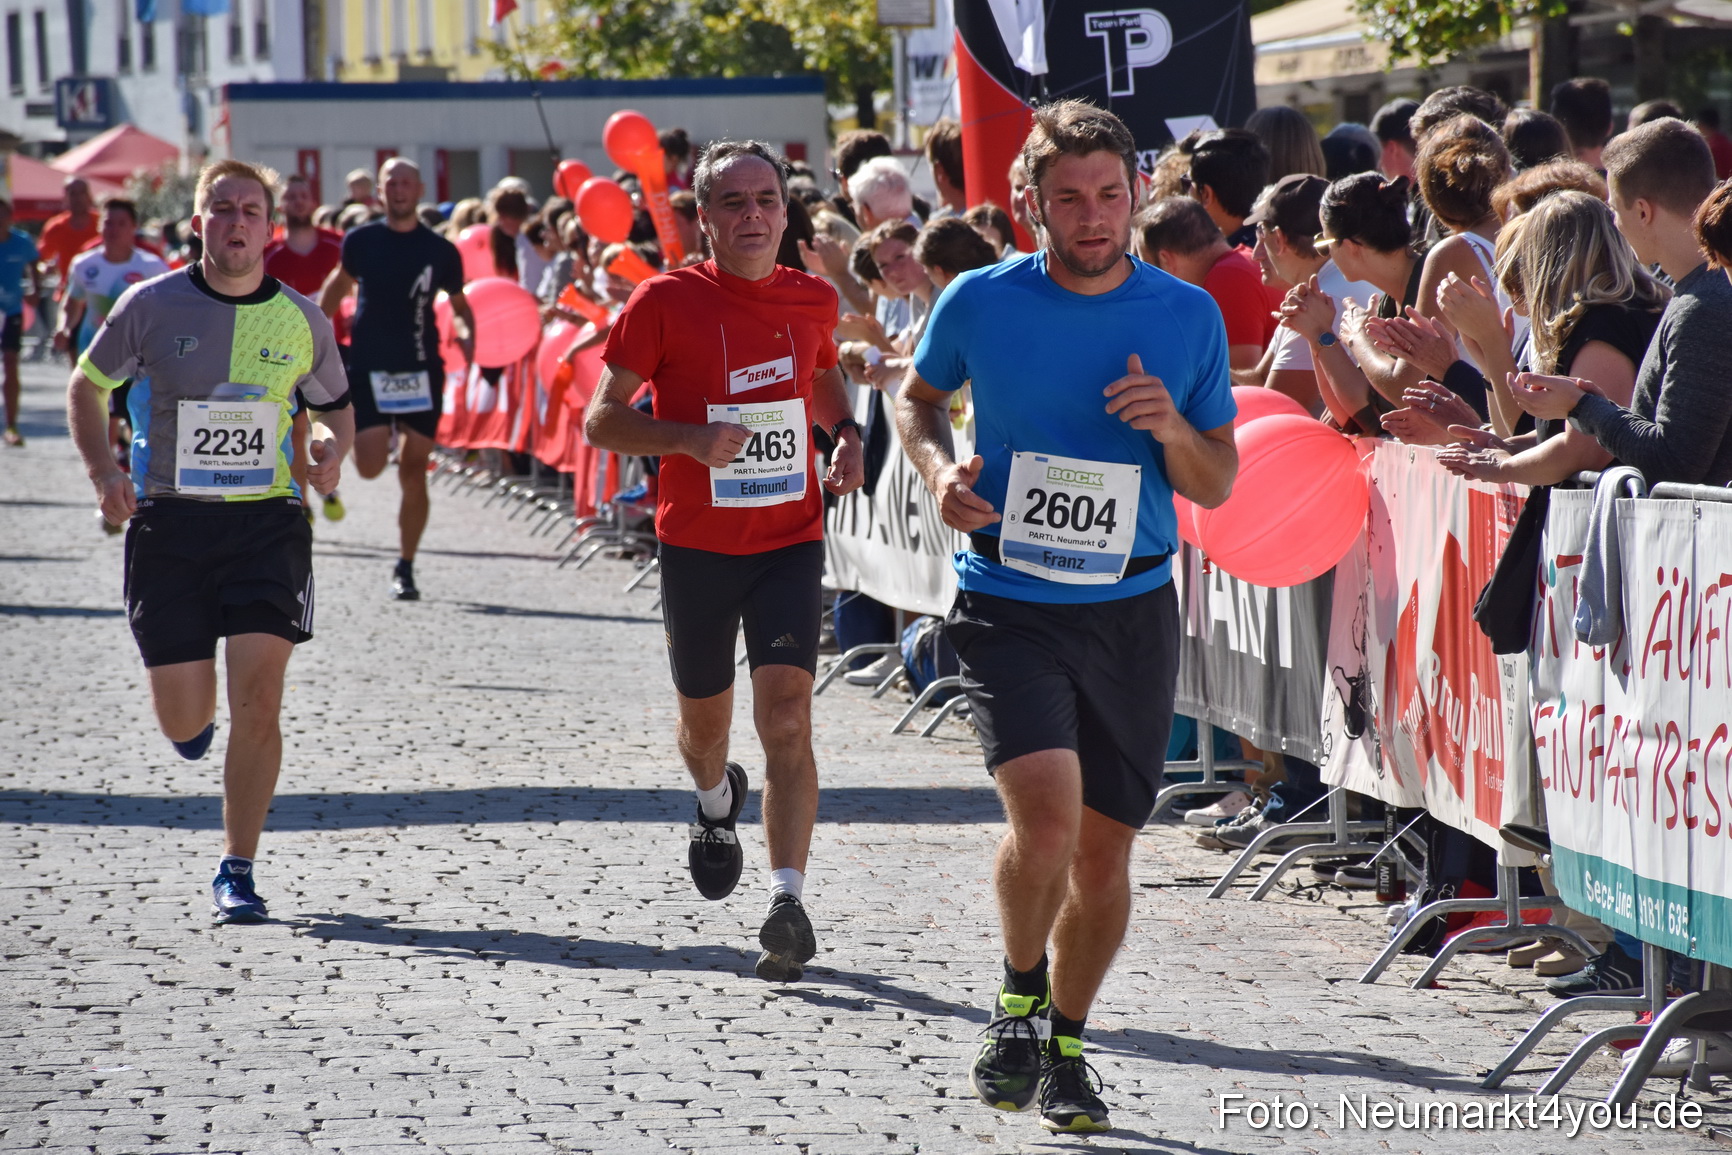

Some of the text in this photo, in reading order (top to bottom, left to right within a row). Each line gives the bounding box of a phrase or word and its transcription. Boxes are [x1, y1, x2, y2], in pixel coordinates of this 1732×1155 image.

[747, 366, 776, 384] DEHN
[380, 374, 422, 393] 2383
[209, 410, 254, 421] BOCK
[740, 410, 784, 425] BOCK
[193, 427, 266, 456] 2234
[734, 465, 786, 475] PARTL Neumarkt
[1047, 466, 1105, 487] BOCK
[213, 472, 246, 485] Peter
[740, 479, 788, 495] Edmund
[1010, 513, 1016, 521] B
[1022, 488, 1117, 535] 2604
[1028, 531, 1095, 547] PARTL Neumarkt
[1043, 550, 1087, 570] Franz
[771, 641, 800, 649] adidas
[1380, 865, 1389, 887] now
